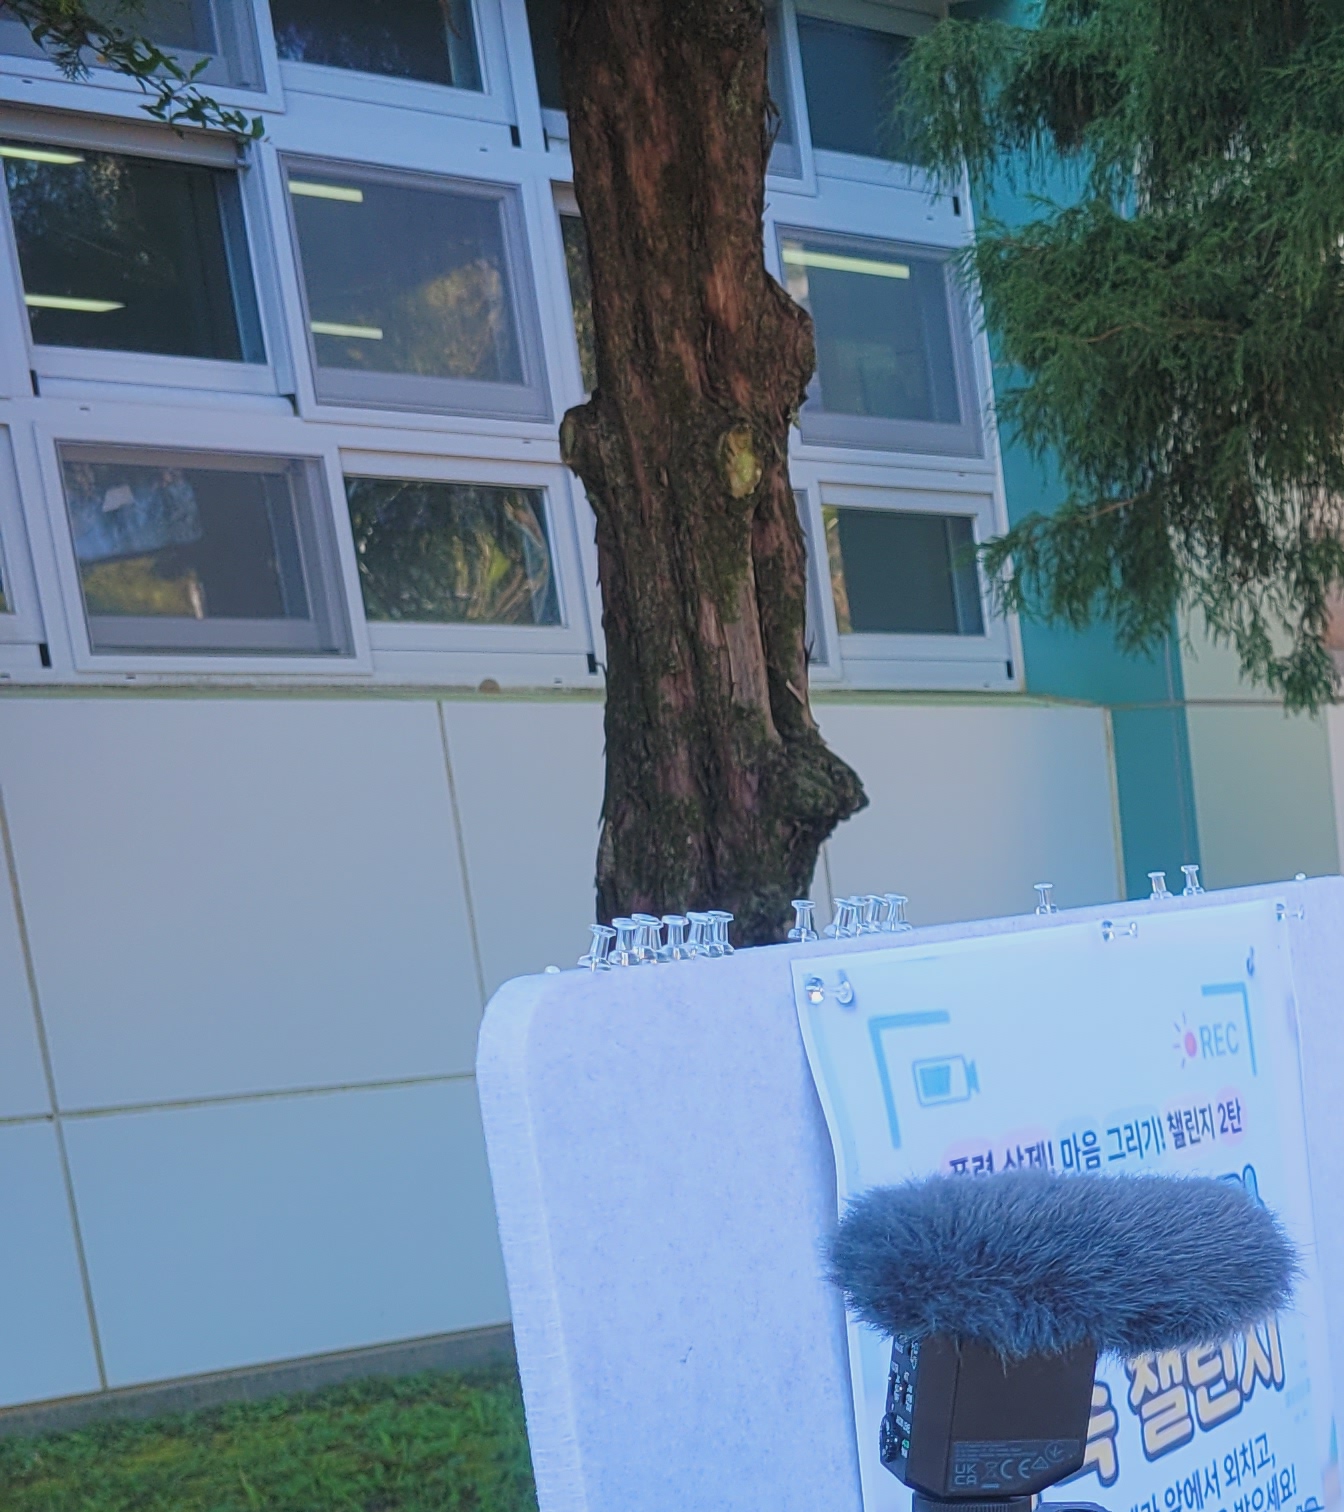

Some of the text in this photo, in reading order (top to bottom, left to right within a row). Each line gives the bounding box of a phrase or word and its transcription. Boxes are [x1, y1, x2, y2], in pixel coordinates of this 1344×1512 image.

[1199, 1021, 1239, 1060] REC
[1060, 1129, 1101, 1173] 마음
[1107, 1114, 1167, 1162] 그리기!
[1167, 1103, 1216, 1151] 챌린지
[1217, 1097, 1243, 1135] 2탄
[1223, 1432, 1276, 1487] 외치고,
